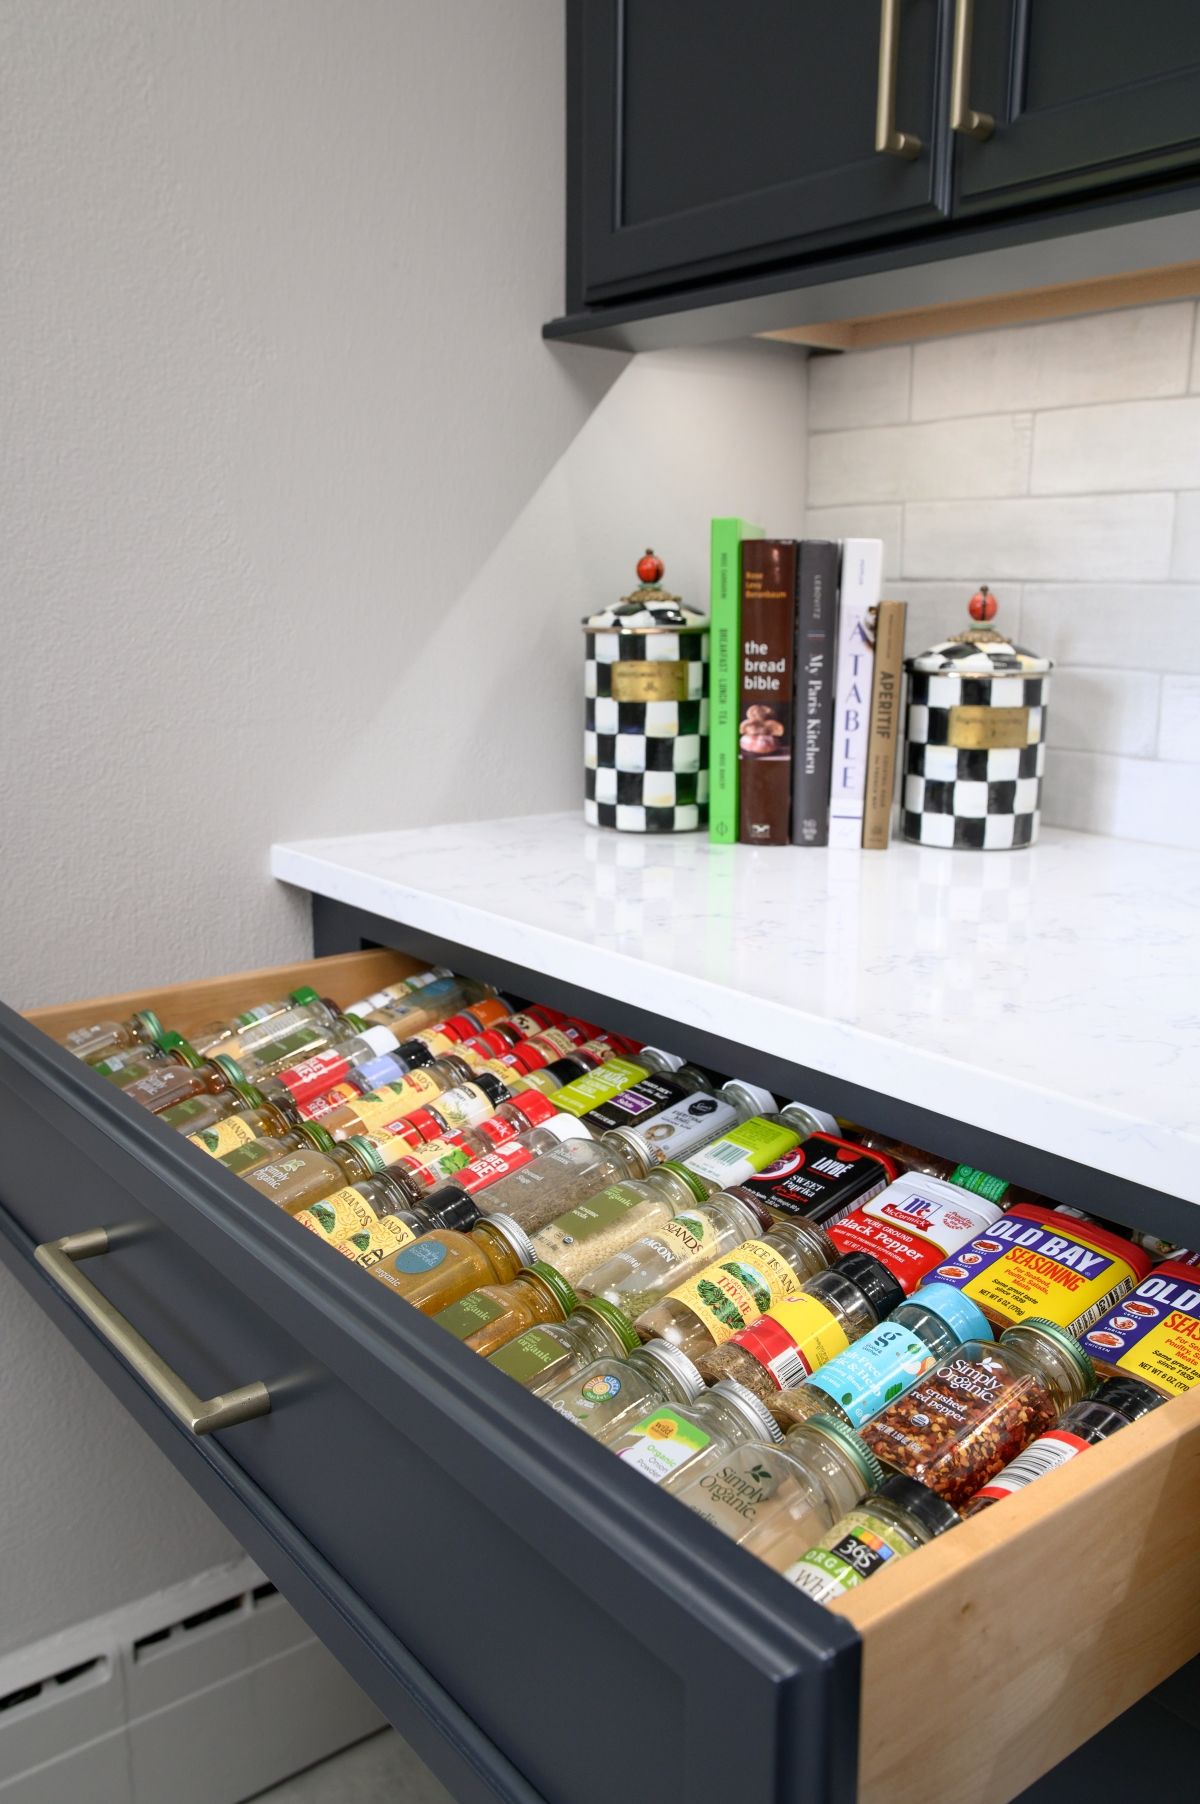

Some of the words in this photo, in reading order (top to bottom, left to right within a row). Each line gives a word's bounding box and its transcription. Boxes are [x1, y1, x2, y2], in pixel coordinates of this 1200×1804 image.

[744, 640, 769, 655] the
[744, 658, 786, 673] bread
[804, 654, 824, 675] My
[744, 676, 780, 691] bible
[807, 680, 823, 715] Paris
[805, 718, 821, 775] Kitchen
[782, 1179, 816, 1198] Paprika
[789, 1174, 825, 1191] SWEET
[884, 1206, 929, 1227] McCormick
[837, 1218, 875, 1237] Black
[873, 1231, 925, 1261] Pepper
[863, 1217, 883, 1230] PURE
[882, 1225, 914, 1244] GROUND
[985, 1219, 1039, 1246] OLD
[1038, 1232, 1102, 1273] BAY
[375, 1267, 401, 1287] organic
[737, 1242, 771, 1260] SPICE
[767, 1257, 796, 1294] ISLAN
[1005, 1247, 1087, 1292] SEASONING
[1013, 1265, 1026, 1275] For
[1024, 1270, 1051, 1288] Seafood,
[991, 1278, 1009, 1289] Same
[1006, 1284, 1024, 1298] great
[1022, 1292, 1039, 1305] taste
[1004, 1268, 1028, 1283] Poultry,
[1027, 1278, 1050, 1295] Salads,
[1012, 1277, 1032, 1293] Meats
[717, 1275, 752, 1316] THYME
[978, 1288, 990, 1297] NET
[988, 1293, 999, 1302] WT
[1000, 1299, 1010, 1308] OZ
[1008, 1302, 1026, 1317] (170g)
[994, 1285, 1012, 1296] since
[1010, 1292, 1027, 1304] 1939
[1135, 1277, 1200, 1312] OLD
[1103, 1326, 1127, 1336] SHRIMP
[1175, 1335, 1190, 1346] For
[1084, 1342, 1111, 1353] CHICKEN
[1164, 1338, 1191, 1356] Poultry,
[1152, 1350, 1172, 1362] Same
[1171, 1357, 1192, 1373] great
[1156, 1359, 1177, 1372] since
[1175, 1367, 1195, 1381] 1939
[1175, 1351, 1199, 1367] Meats
[950, 1359, 1004, 1391] Simply
[1138, 1361, 1152, 1372] NET
[1151, 1366, 1163, 1377] WT
[1166, 1374, 1178, 1385] OZ
[911, 1390, 930, 1403] red
[928, 1399, 967, 1423] pepper
[925, 1388, 968, 1412] crushed
[654, 1420, 675, 1437] wild
[647, 1445, 677, 1468] Organic
[648, 1457, 669, 1473] Onion
[636, 1459, 662, 1479] Powder
[716, 1466, 769, 1506] Simply
[839, 1539, 877, 1569] 365
